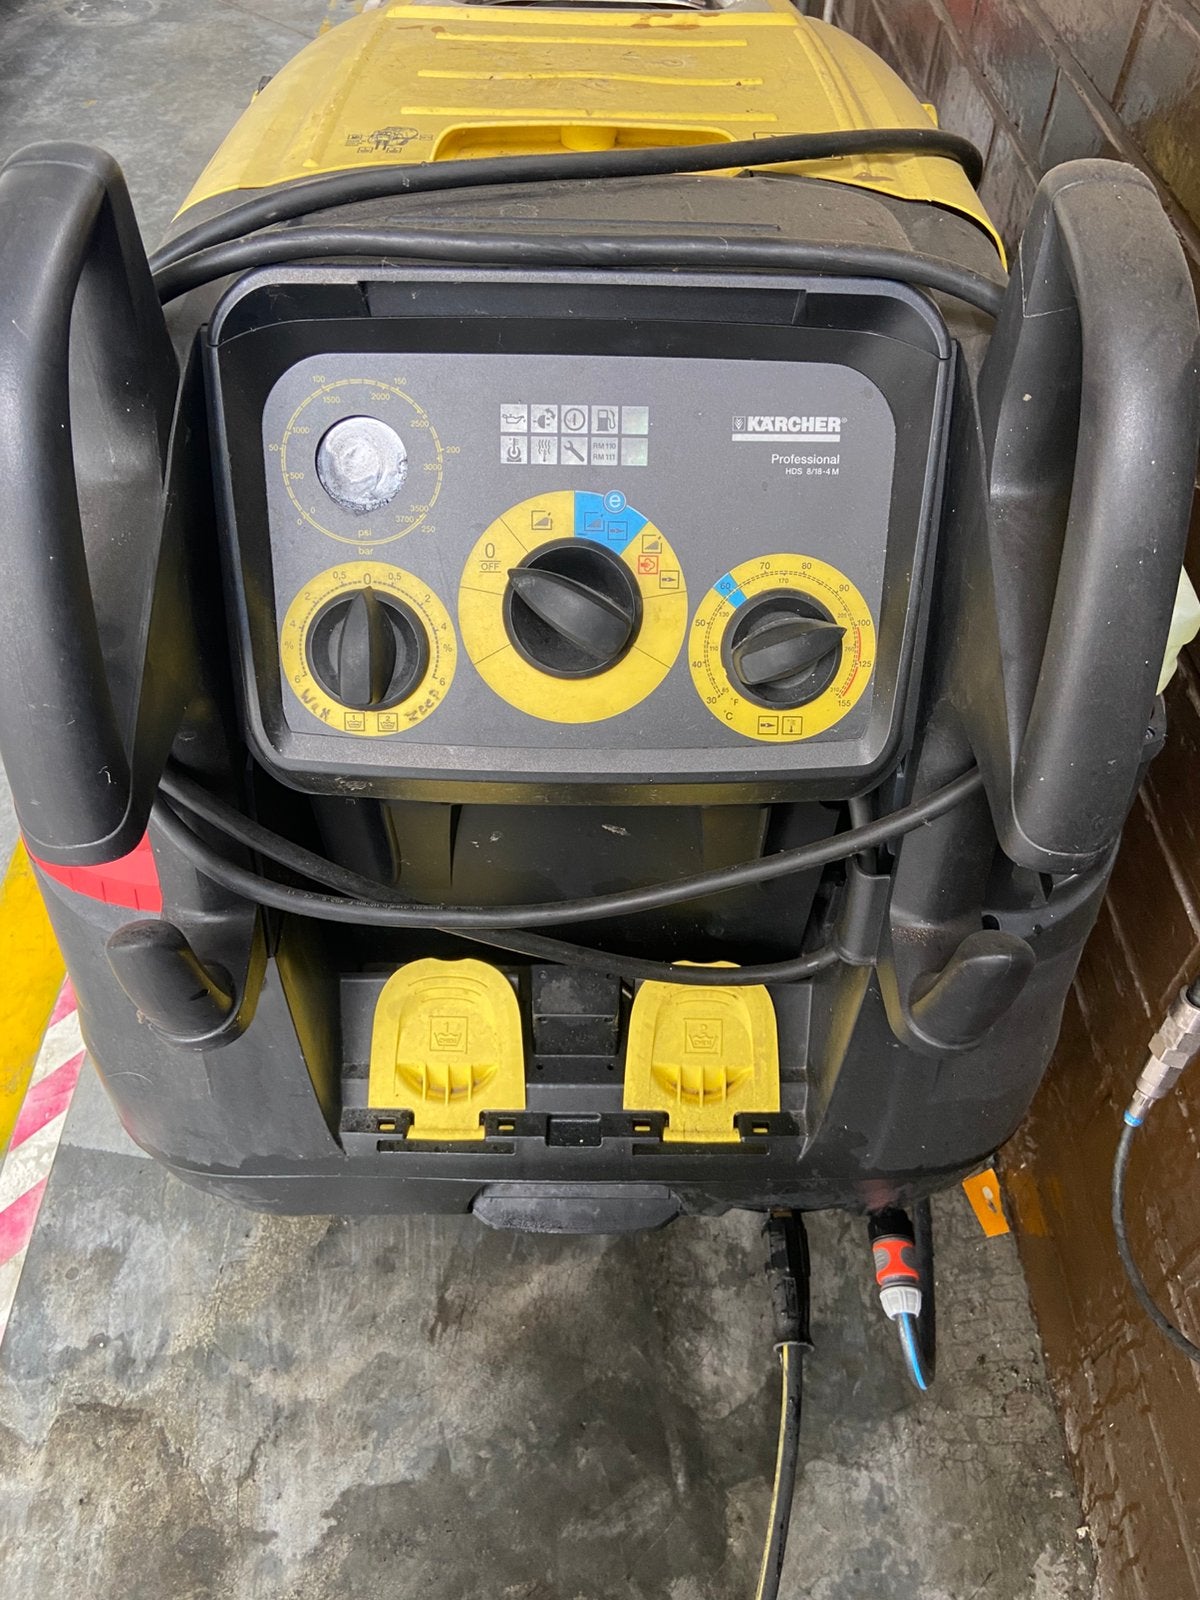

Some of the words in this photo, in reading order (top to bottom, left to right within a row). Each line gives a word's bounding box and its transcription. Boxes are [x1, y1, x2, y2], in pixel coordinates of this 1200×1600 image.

[323, 396, 341, 404] 1500
[370, 393, 390, 401] 2000
[410, 420, 430, 428] 2500
[747, 416, 841, 432] KÄRCHER
[292, 426, 310, 434] 1000
[268, 444, 278, 452] 50
[446, 446, 460, 454] 200
[771, 454, 840, 464] Professional
[423, 463, 442, 471] 3000
[290, 472, 304, 480] 500
[310, 506, 316, 514] 0
[410, 505, 429, 513] 3500
[297, 518, 302, 526] 0
[395, 515, 414, 523] 3700
[358, 528, 372, 537] psi
[421, 525, 435, 533] 250
[358, 547, 373, 556] bar
[485, 543, 495, 558] 0
[481, 562, 499, 571] OFF
[760, 562, 771, 570] 70
[802, 562, 812, 570] 80
[363, 573, 372, 585] 0
[720, 582, 731, 590] 60
[839, 584, 850, 592] 90
[425, 594, 431, 603] 2
[441, 623, 447, 631] 4
[857, 619, 871, 627] 100
[858, 660, 872, 668] 125
[294, 675, 301, 683] 6
[440, 677, 446, 686] 6
[706, 696, 717, 704] 30
